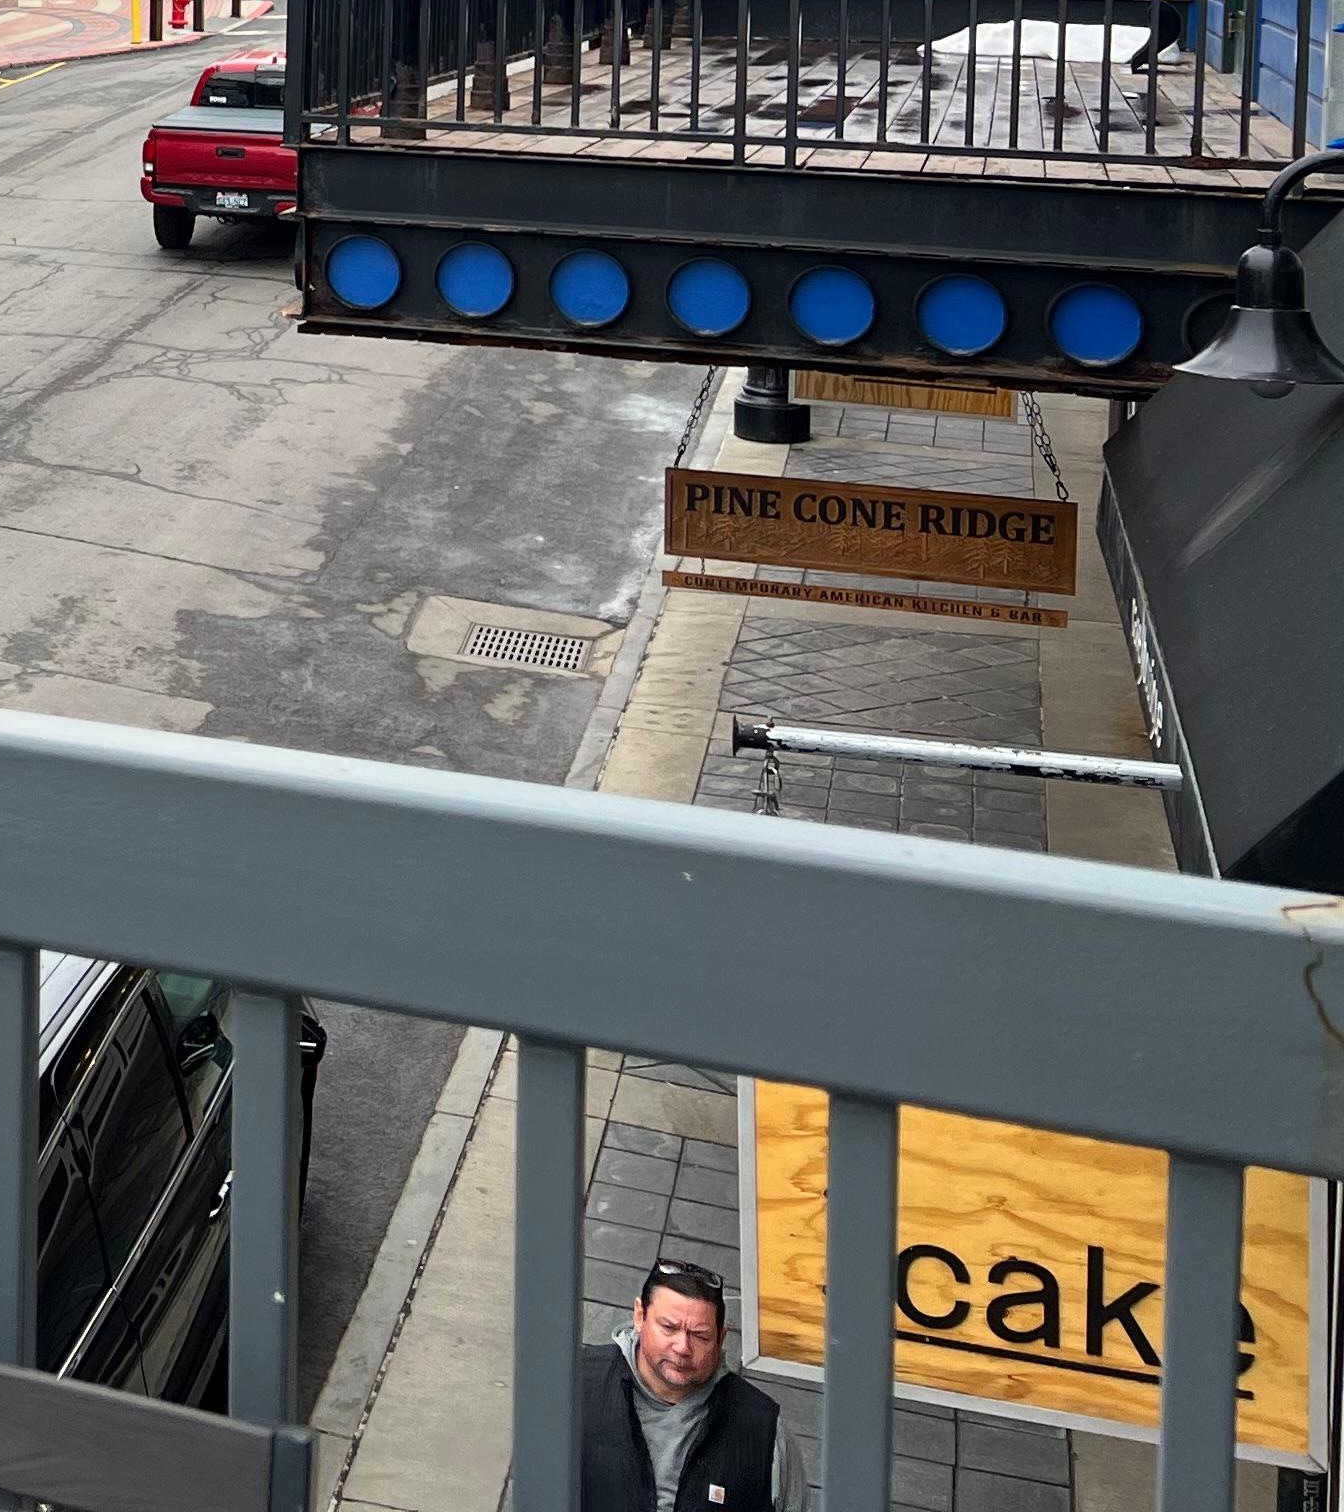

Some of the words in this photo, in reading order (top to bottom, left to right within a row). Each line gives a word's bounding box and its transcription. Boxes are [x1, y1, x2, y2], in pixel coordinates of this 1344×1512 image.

[685, 483, 781, 520] PINE
[793, 493, 906, 531] CONE
[918, 503, 1055, 545] RIDGE
[684, 575, 813, 598] CONTEMPORARY
[819, 590, 904, 608] AMERICAN
[912, 599, 982, 617] KITCHEN
[990, 607, 1000, 618] &
[1009, 609, 1042, 624] BAR
[895, 1244, 1257, 1376] cak
